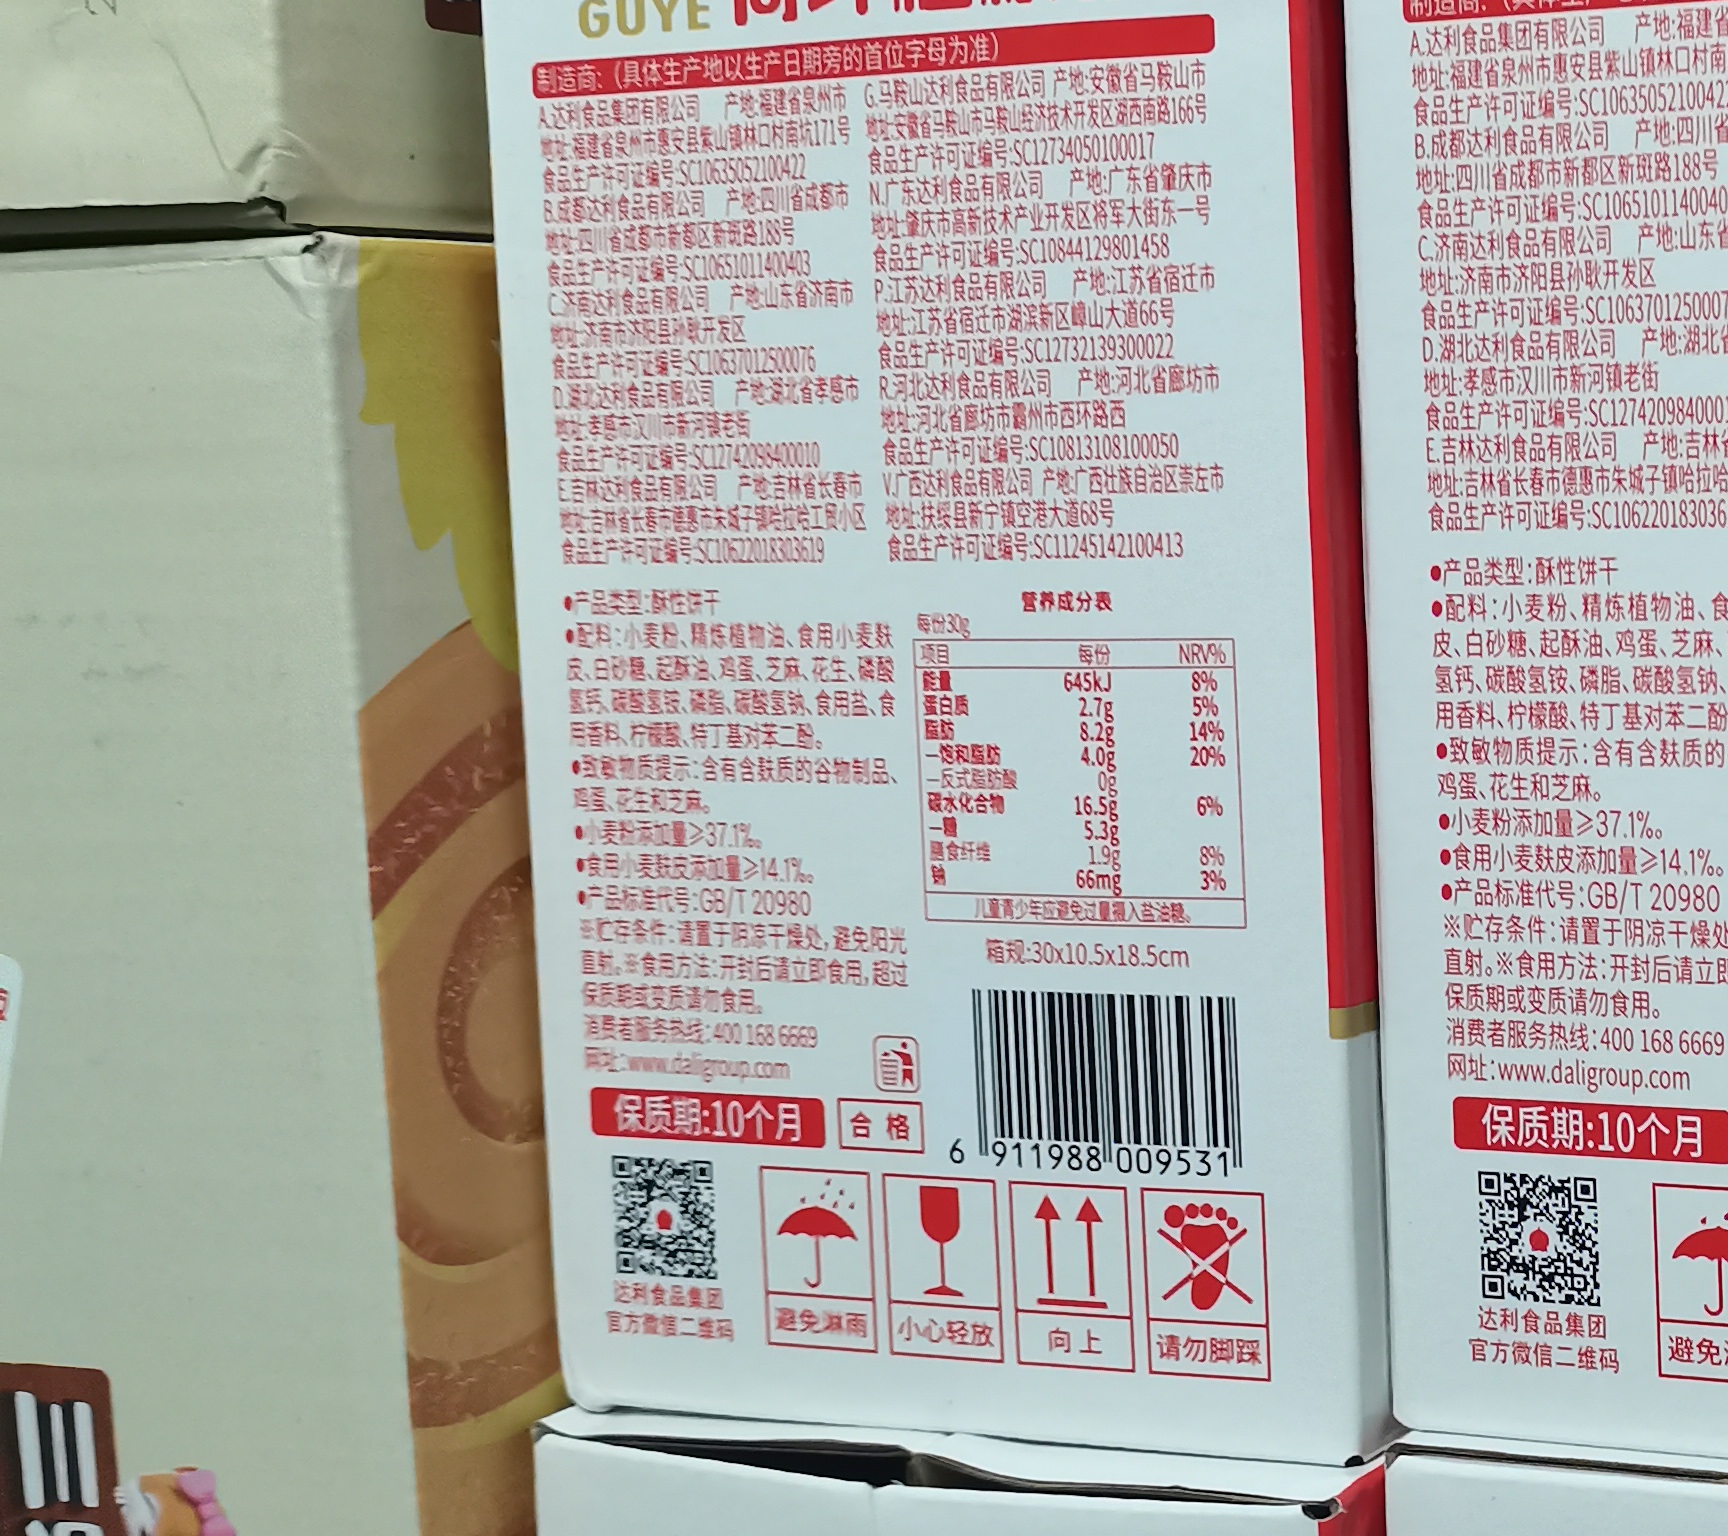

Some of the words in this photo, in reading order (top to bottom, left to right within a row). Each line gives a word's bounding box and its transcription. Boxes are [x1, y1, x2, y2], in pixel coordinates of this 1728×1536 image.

[1410, 16, 1604, 57] A.达利食品集团有限公司
[1414, 121, 1608, 161] B.成都达利食品有限公司
[1418, 225, 1611, 263] C.济南达利食品有限公司
[1422, 328, 1615, 364] D.湖北达利食品有限公司
[1426, 431, 1617, 465] E.吉林达利食品有限公司
[1650, 884, 1720, 913] 20980
[1641, 1029, 1673, 1054] 168
[1679, 1030, 1725, 1056] 6669
[614, 1095, 802, 1143] 保质期:10个月
[1481, 1103, 1703, 1159] 保质期:10个月
[949, 1138, 965, 1164] 6
[992, 1141, 1102, 1173] 911988
[1116, 1147, 1231, 1178] 009531
[1478, 1306, 1606, 1341] 达利食品集团
[1154, 1334, 1262, 1372] 请勿脚踩
[1469, 1339, 1619, 1374] 官方微信二维码
